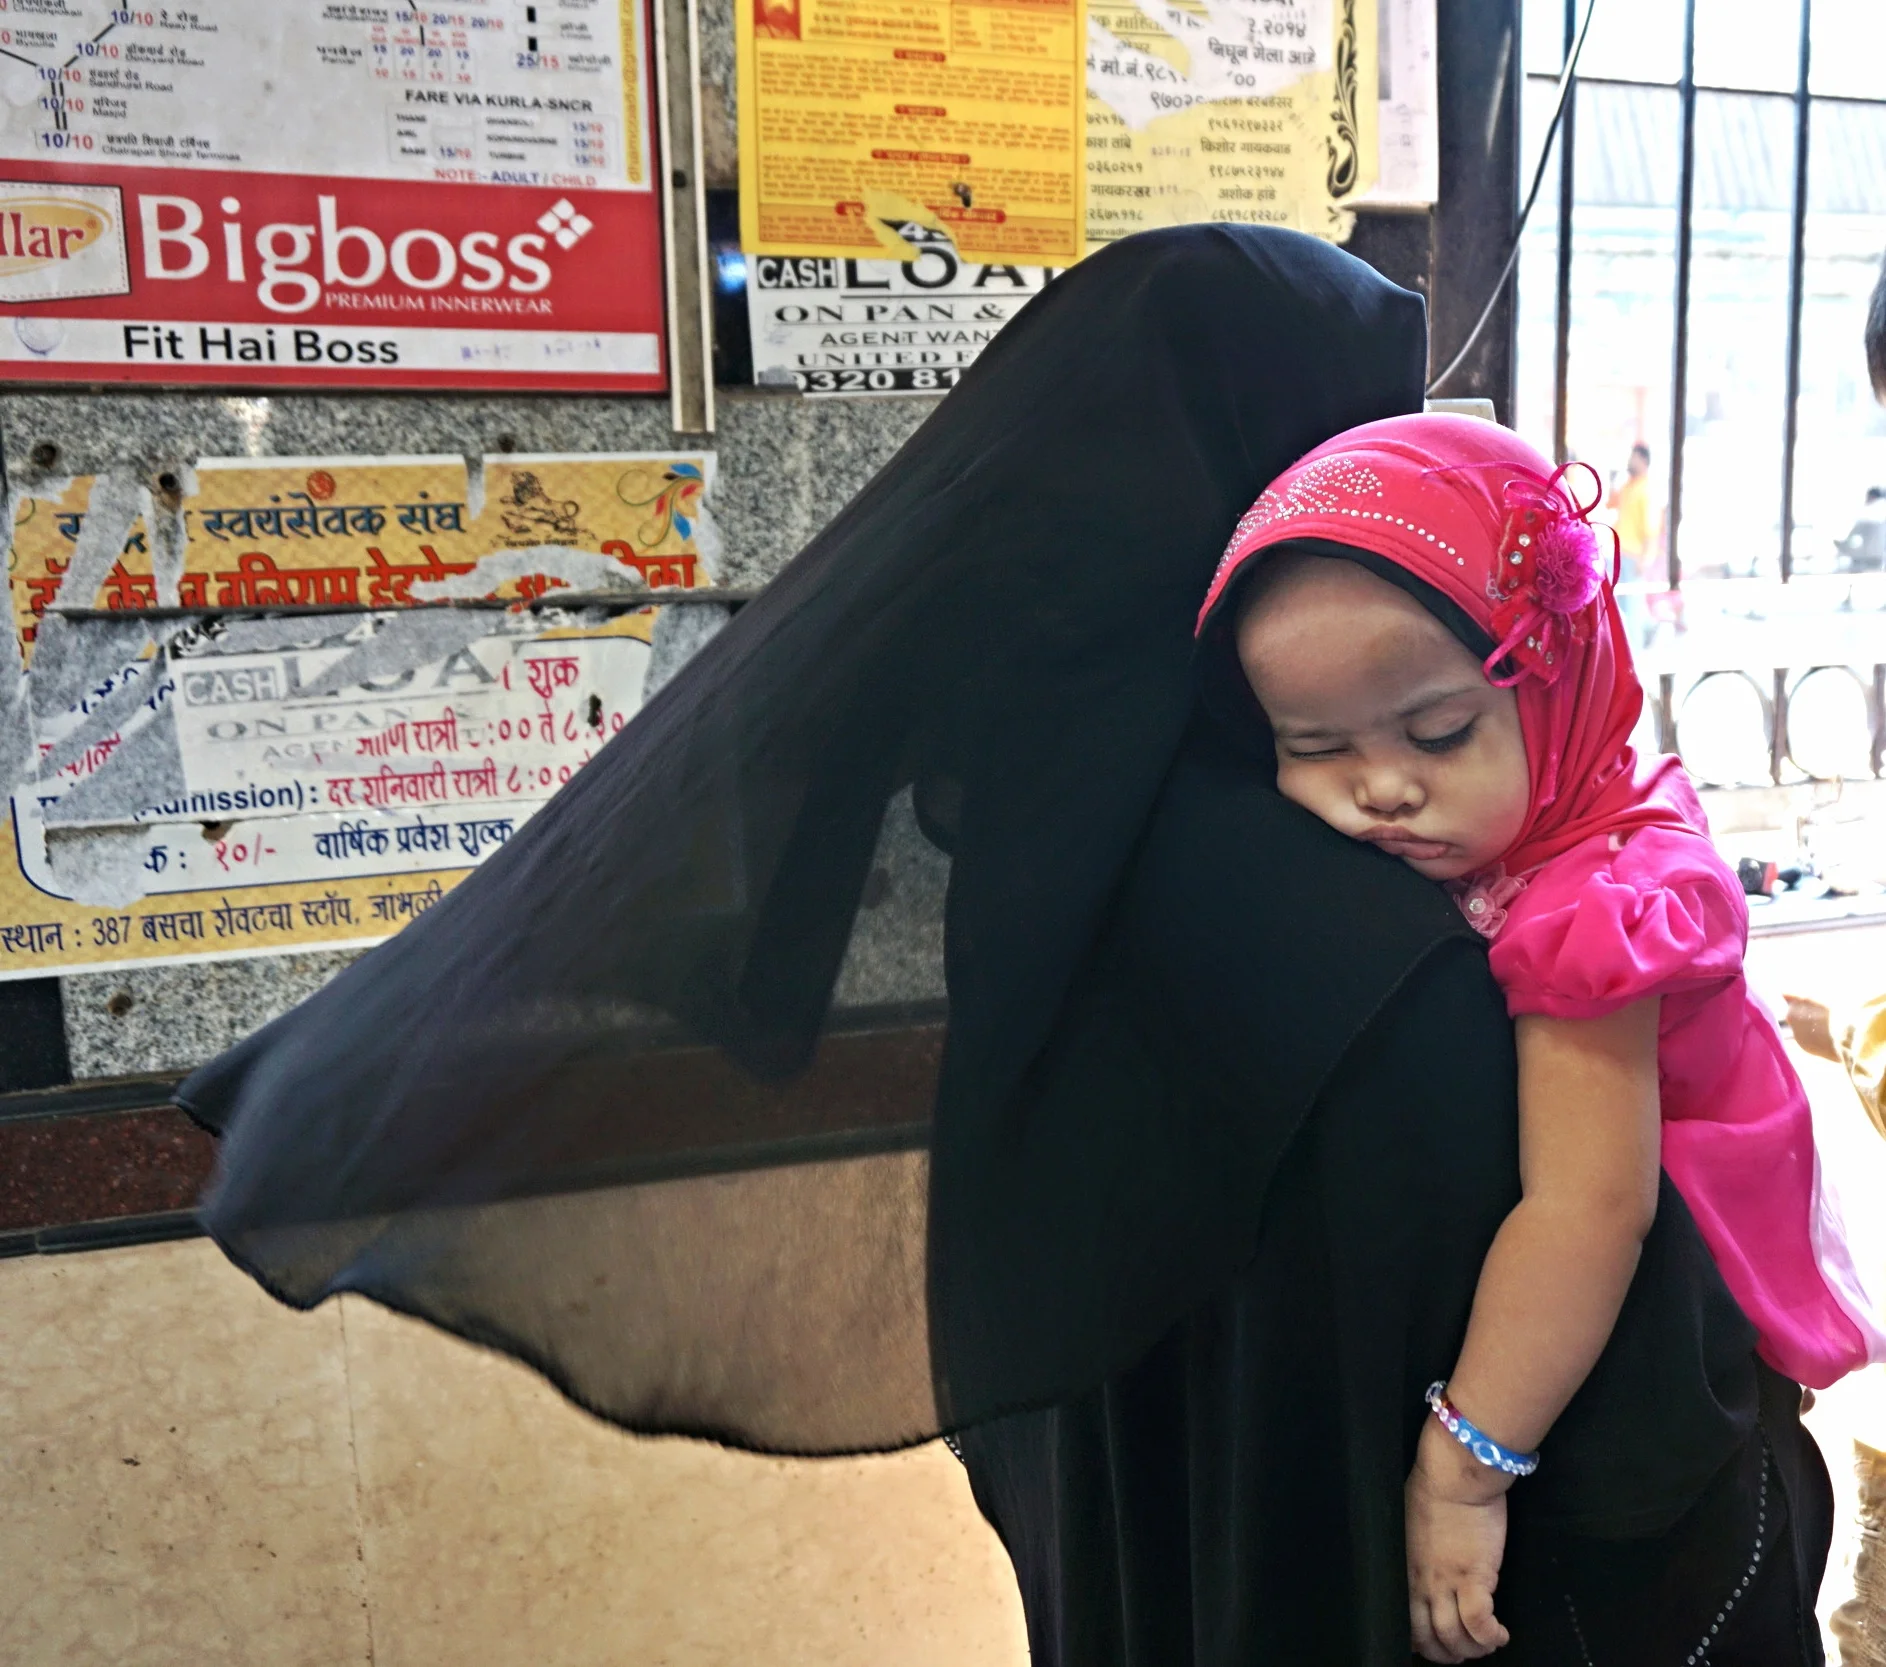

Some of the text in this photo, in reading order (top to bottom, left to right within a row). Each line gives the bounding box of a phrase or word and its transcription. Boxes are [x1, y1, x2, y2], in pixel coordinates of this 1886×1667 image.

[111, 9, 154, 27] 10/10
[76, 42, 119, 59] 10/10
[1208, 36, 1249, 65] निघून
[39, 67, 82, 83] 10/10
[41, 97, 85, 113] 10/10
[405, 89, 449, 104] FARE
[453, 92, 482, 106] VIA
[41, 133, 94, 149] 10/10
[1200, 136, 1236, 153] किशोर
[491, 170, 540, 185] ADULT
[551, 173, 598, 187] CHILD
[1218, 184, 1254, 201] अशोक
[138, 193, 553, 314] Bigboss
[757, 257, 839, 289] CASH
[325, 291, 554, 316] PREMIUM INNERWEAR
[774, 302, 1005, 322] ON PAN &
[123, 324, 400, 366] Fit Hai Boss
[820, 331, 918, 346] AGENT
[797, 351, 941, 367] UNITED
[200, 491, 386, 541] स्वयंसेवक
[394, 490, 467, 536] संघ
[184, 669, 276, 705] CASH
[524, 656, 579, 698] शुक्र
[207, 717, 286, 739] ON
[412, 705, 459, 752] रात्री
[538, 702, 556, 745] ते
[326, 778, 356, 807] दर
[359, 760, 449, 808] शनिवारी
[451, 756, 499, 798] रात्री
[314, 819, 389, 859] वार्षिक
[395, 815, 451, 854] प्रवेश
[455, 818, 515, 857] शुल्क
[0, 922, 65, 953] स्थान
[92, 915, 131, 947] 387
[211, 896, 294, 938] शेवटचा
